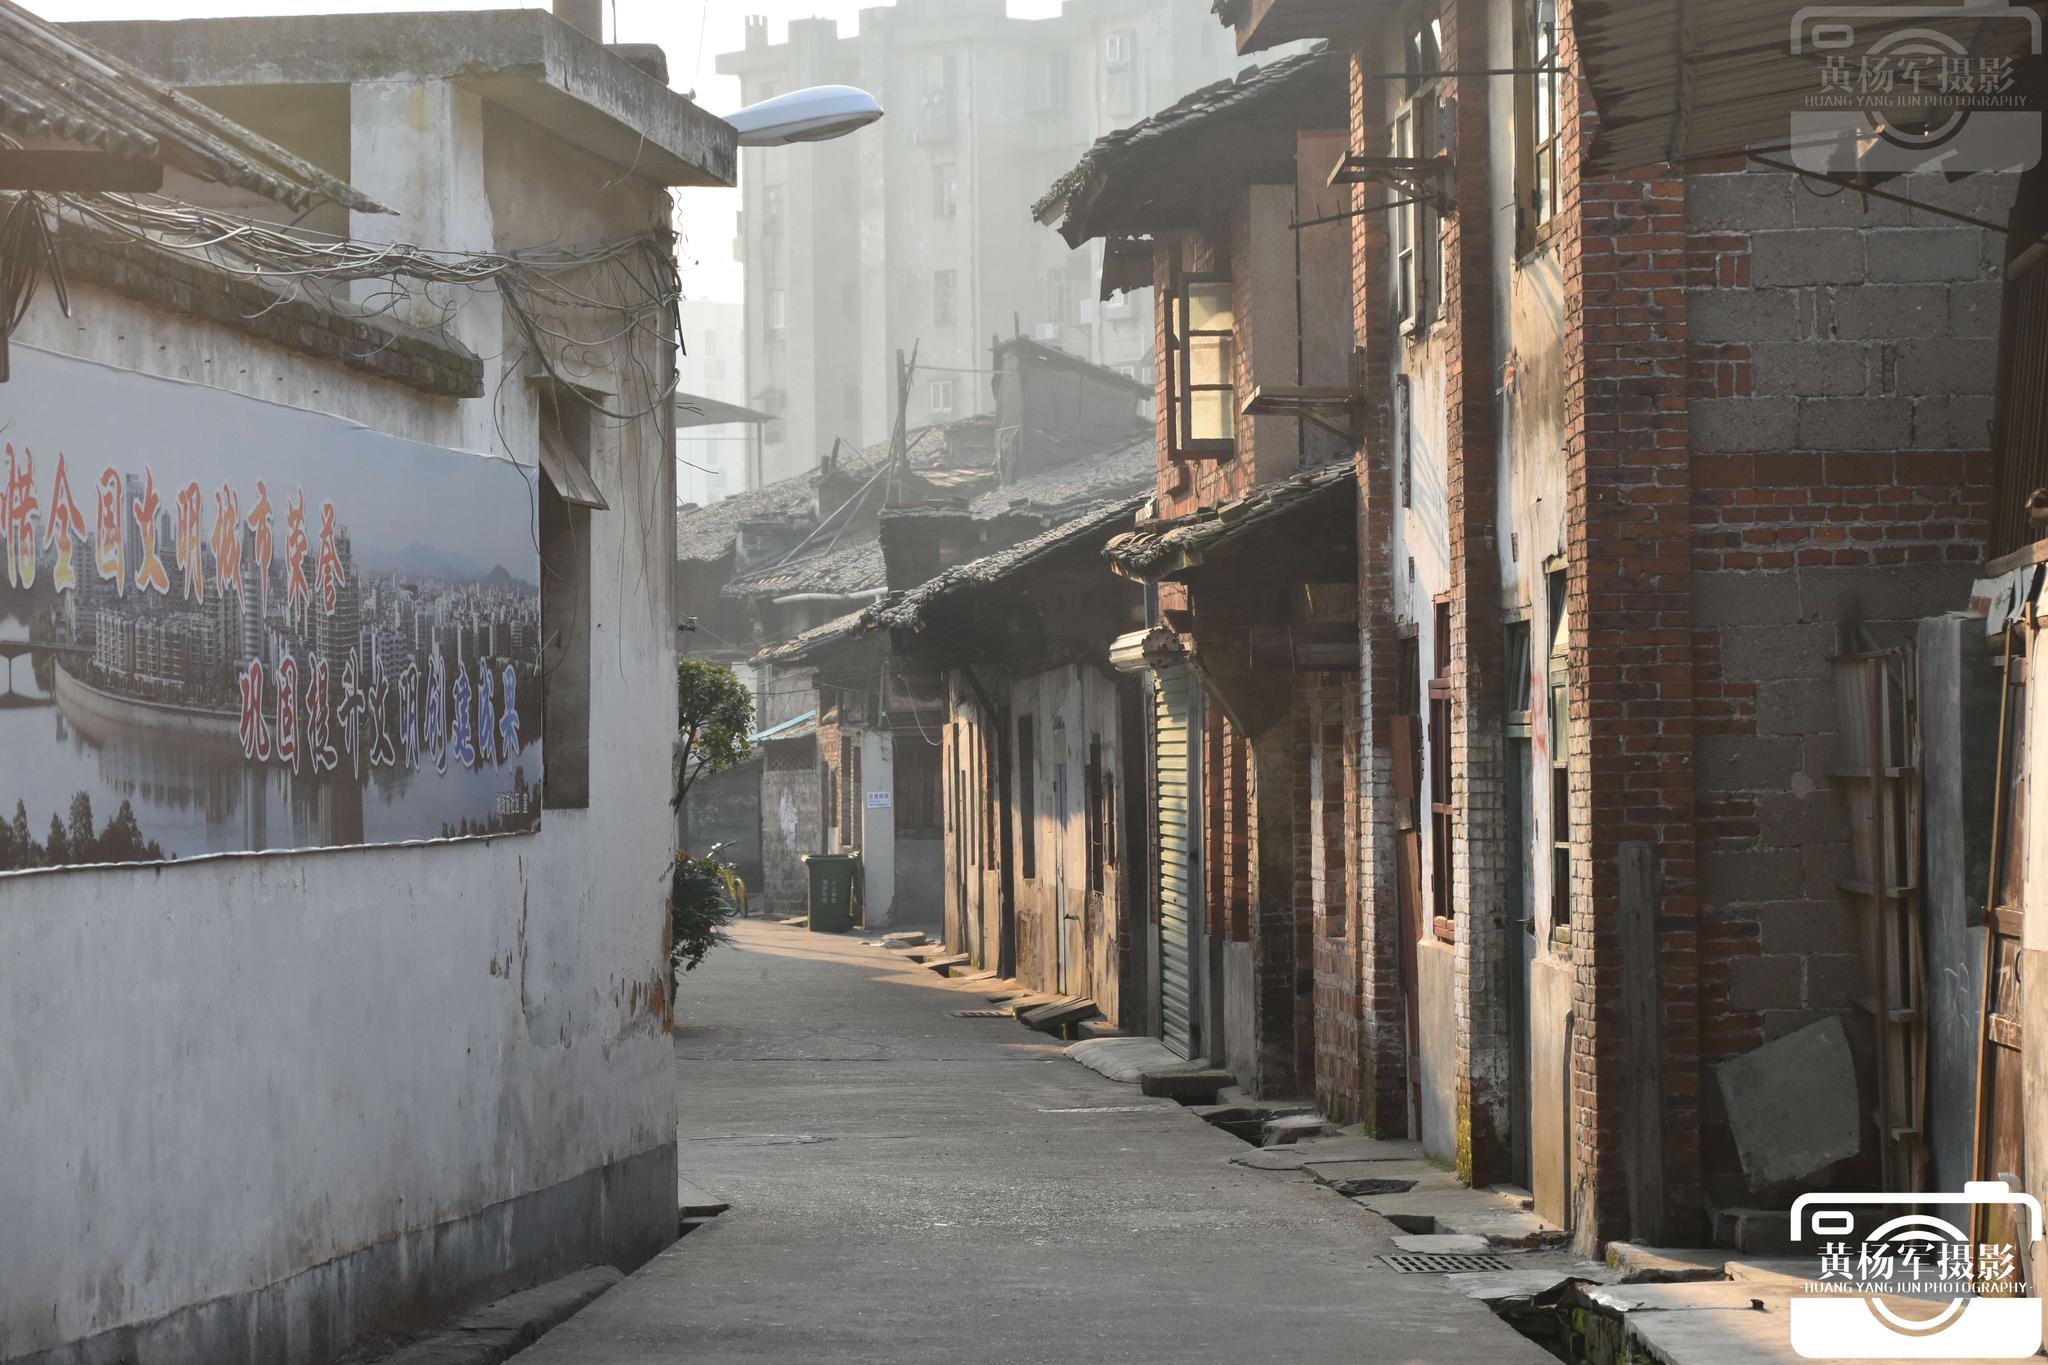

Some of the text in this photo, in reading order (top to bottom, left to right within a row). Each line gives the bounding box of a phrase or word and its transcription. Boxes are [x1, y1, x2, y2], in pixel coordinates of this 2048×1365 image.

[0, 441, 346, 620] 惜全国文明城市荣誉
[239, 647, 520, 779] 巩固提升文明创建成果
